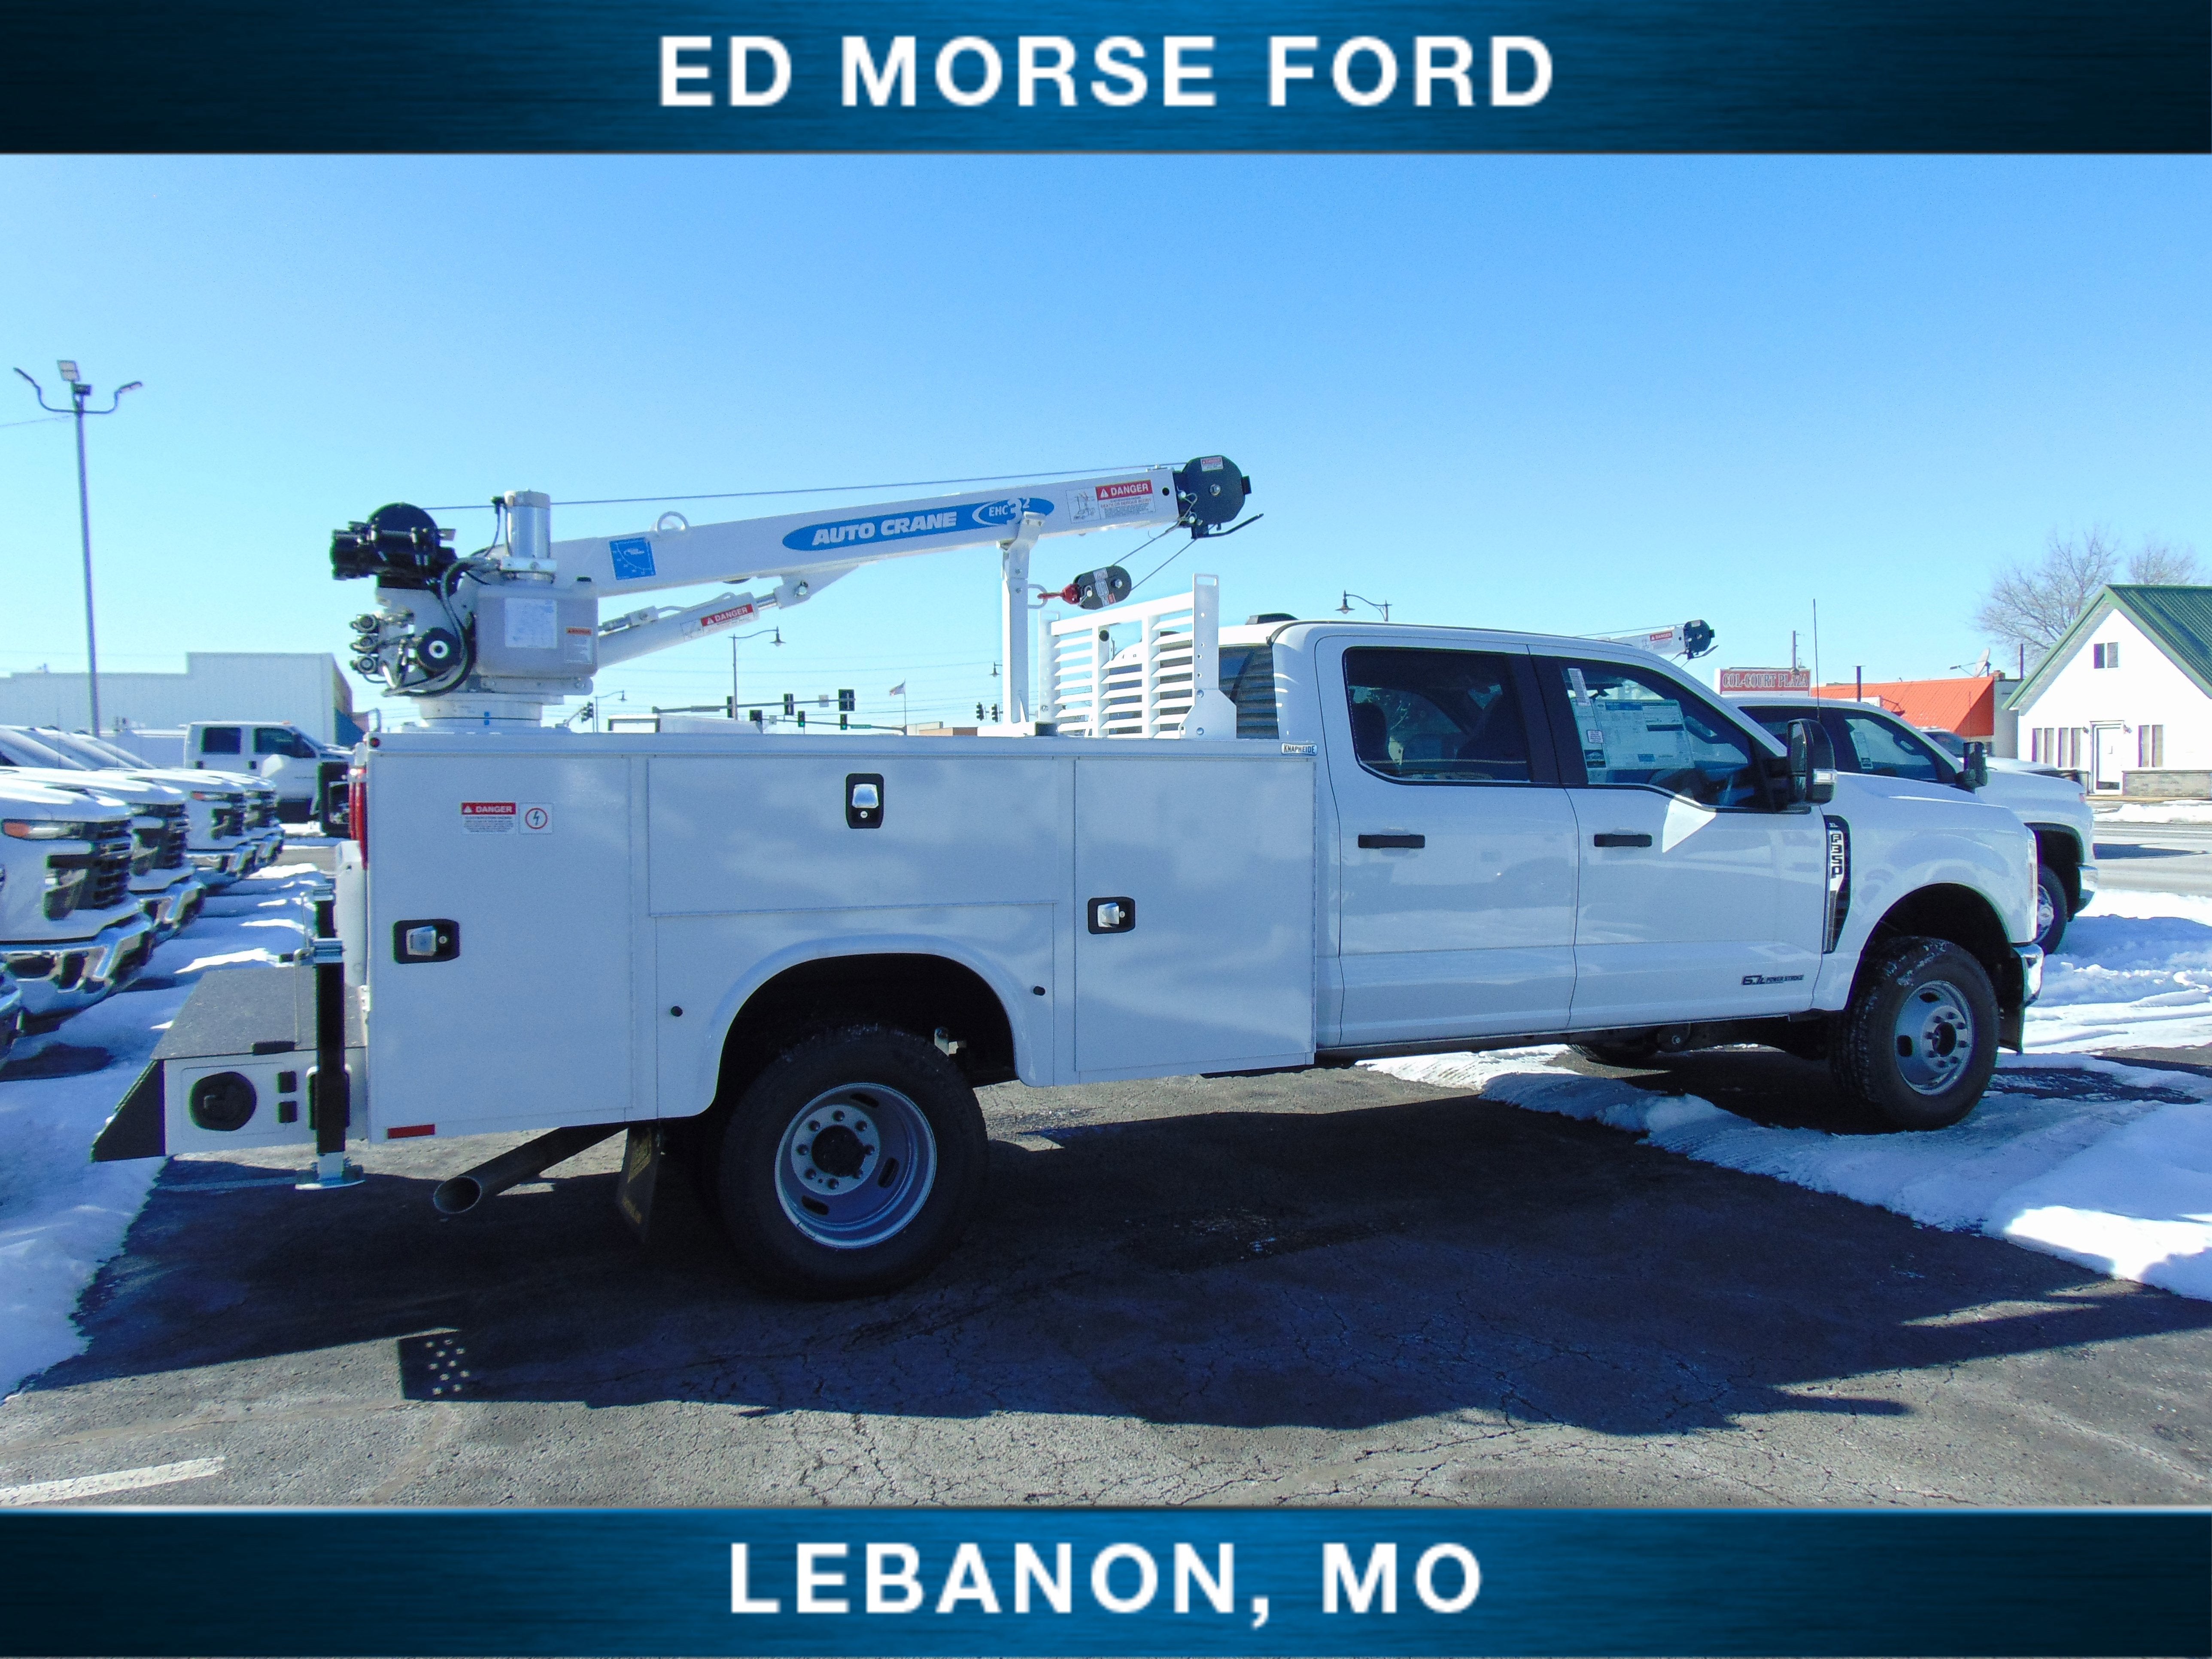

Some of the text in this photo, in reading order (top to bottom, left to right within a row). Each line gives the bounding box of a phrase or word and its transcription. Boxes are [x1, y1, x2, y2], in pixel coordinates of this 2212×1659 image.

[1110, 483, 1149, 496] DANGER
[811, 522, 875, 546] AUTO
[880, 511, 957, 536] CRANE
[989, 505, 1009, 517] EHC
[714, 607, 748, 622] DANGER
[1778, 673, 1809, 687] PLAZA
[1283, 744, 1315, 754] KNAPHEIDE
